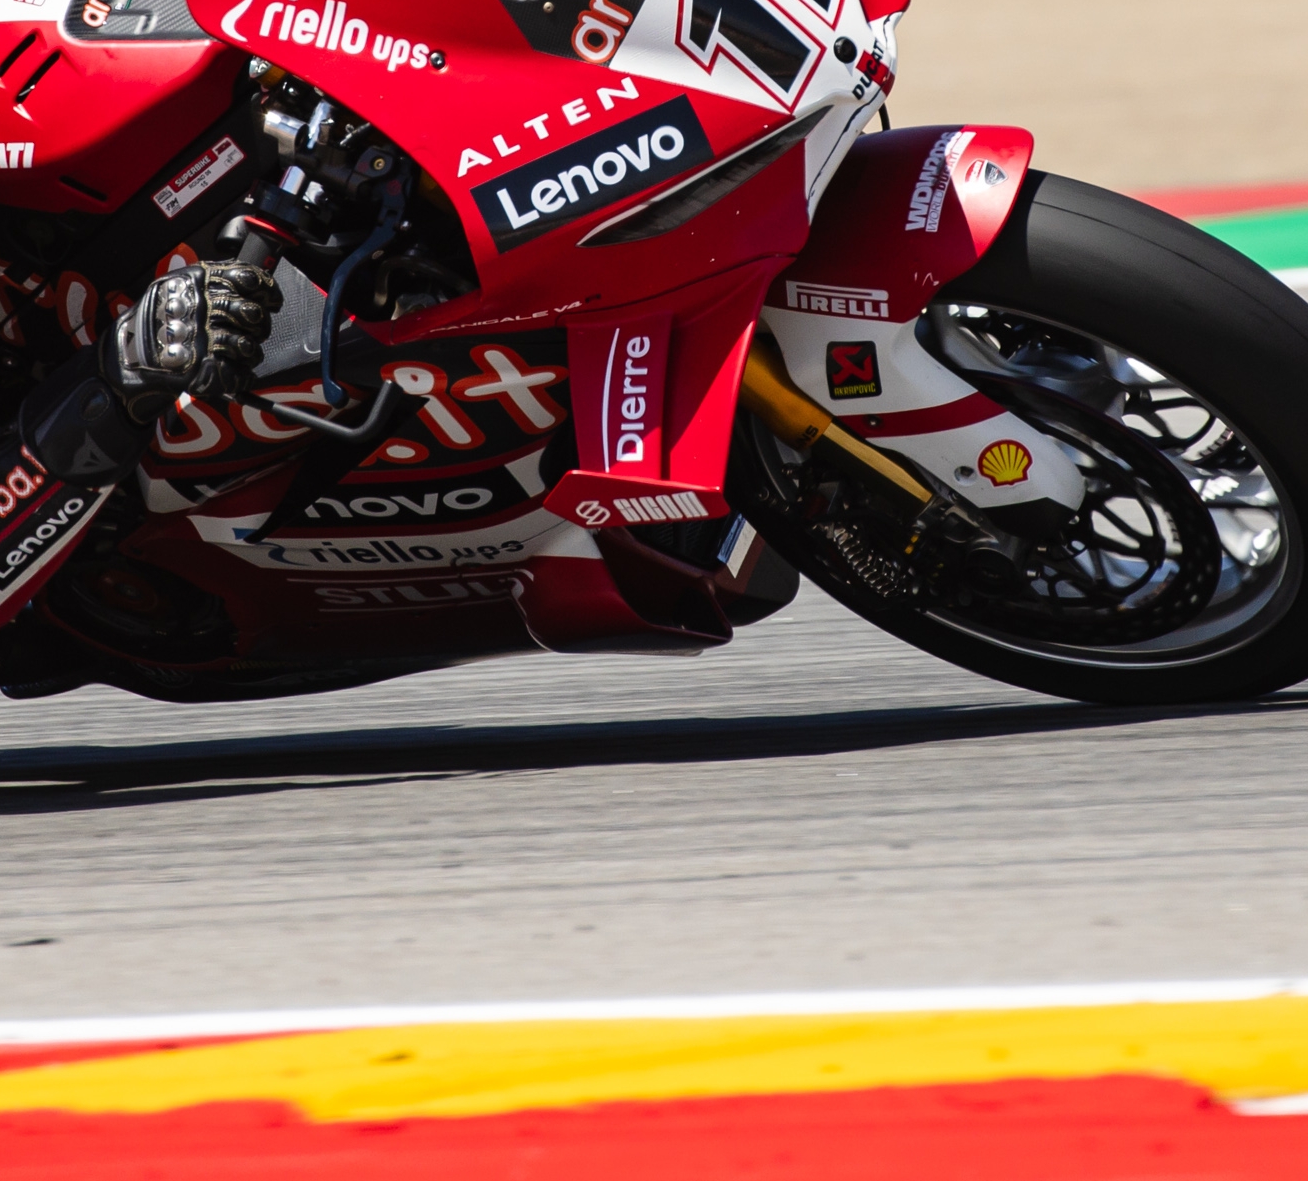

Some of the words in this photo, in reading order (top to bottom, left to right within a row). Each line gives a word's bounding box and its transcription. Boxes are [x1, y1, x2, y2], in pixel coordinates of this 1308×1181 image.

[372, 34, 431, 72] ups
[851, 37, 885, 101] DUCAT
[455, 77, 641, 179] ALTEN
[174, 155, 212, 187] SUPERBIKE
[496, 124, 685, 231] Lenovo
[553, 300, 583, 313] V4
[786, 280, 889, 318] PIRELLI
[304, 487, 493, 519] novo
[308, 540, 444, 564] riello
